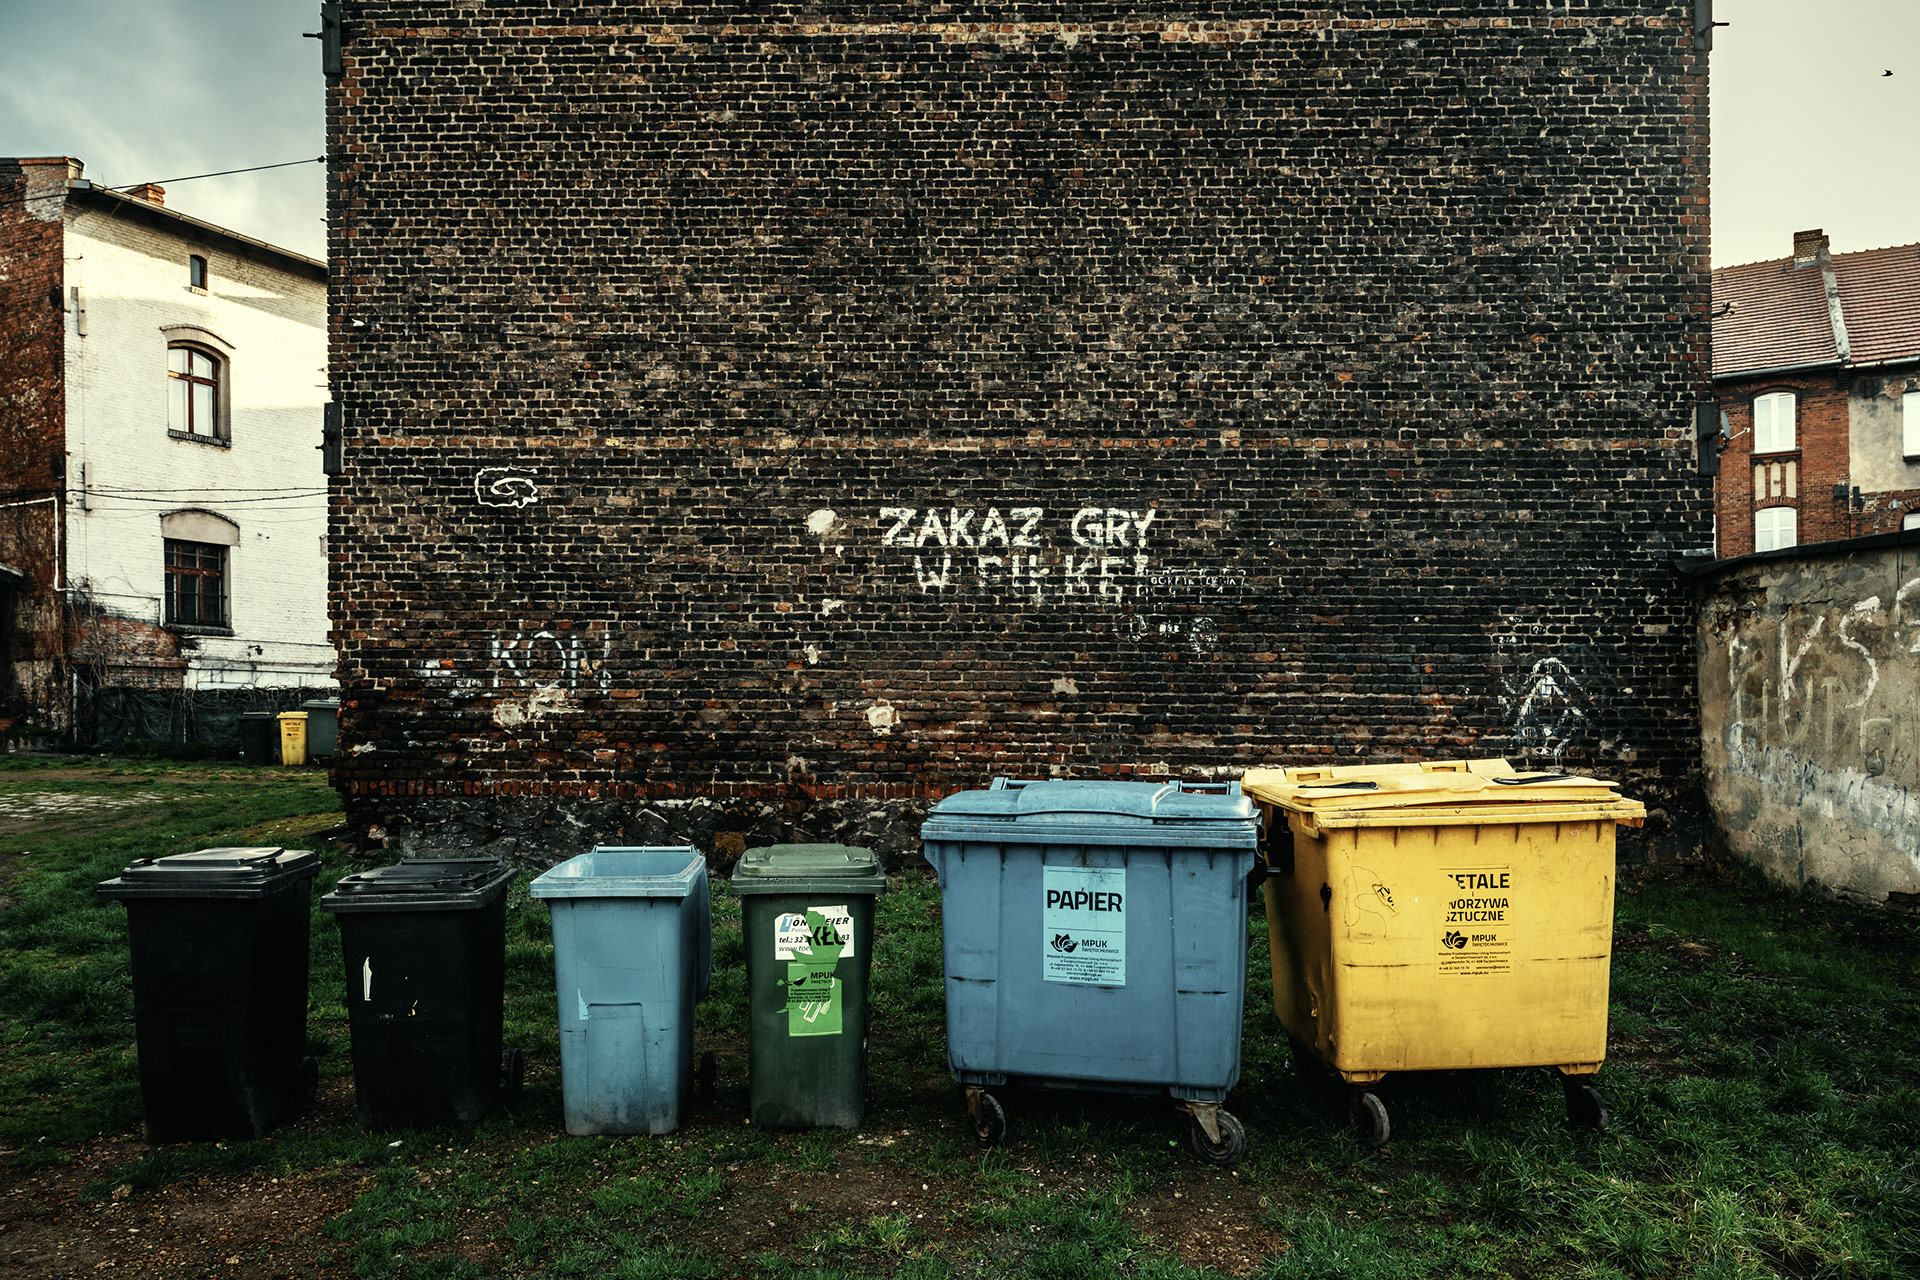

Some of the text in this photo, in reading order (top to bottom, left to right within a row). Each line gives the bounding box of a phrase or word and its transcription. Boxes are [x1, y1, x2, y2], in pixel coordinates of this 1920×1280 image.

[879, 507, 1156, 547] ZAKAZ GRY
[914, 554, 951, 594] W
[1448, 873, 1510, 889] ETALE
[1047, 890, 1122, 912] PAPIER
[1448, 898, 1509, 909] WORZYWA
[1082, 940, 1107, 948] MPUK
